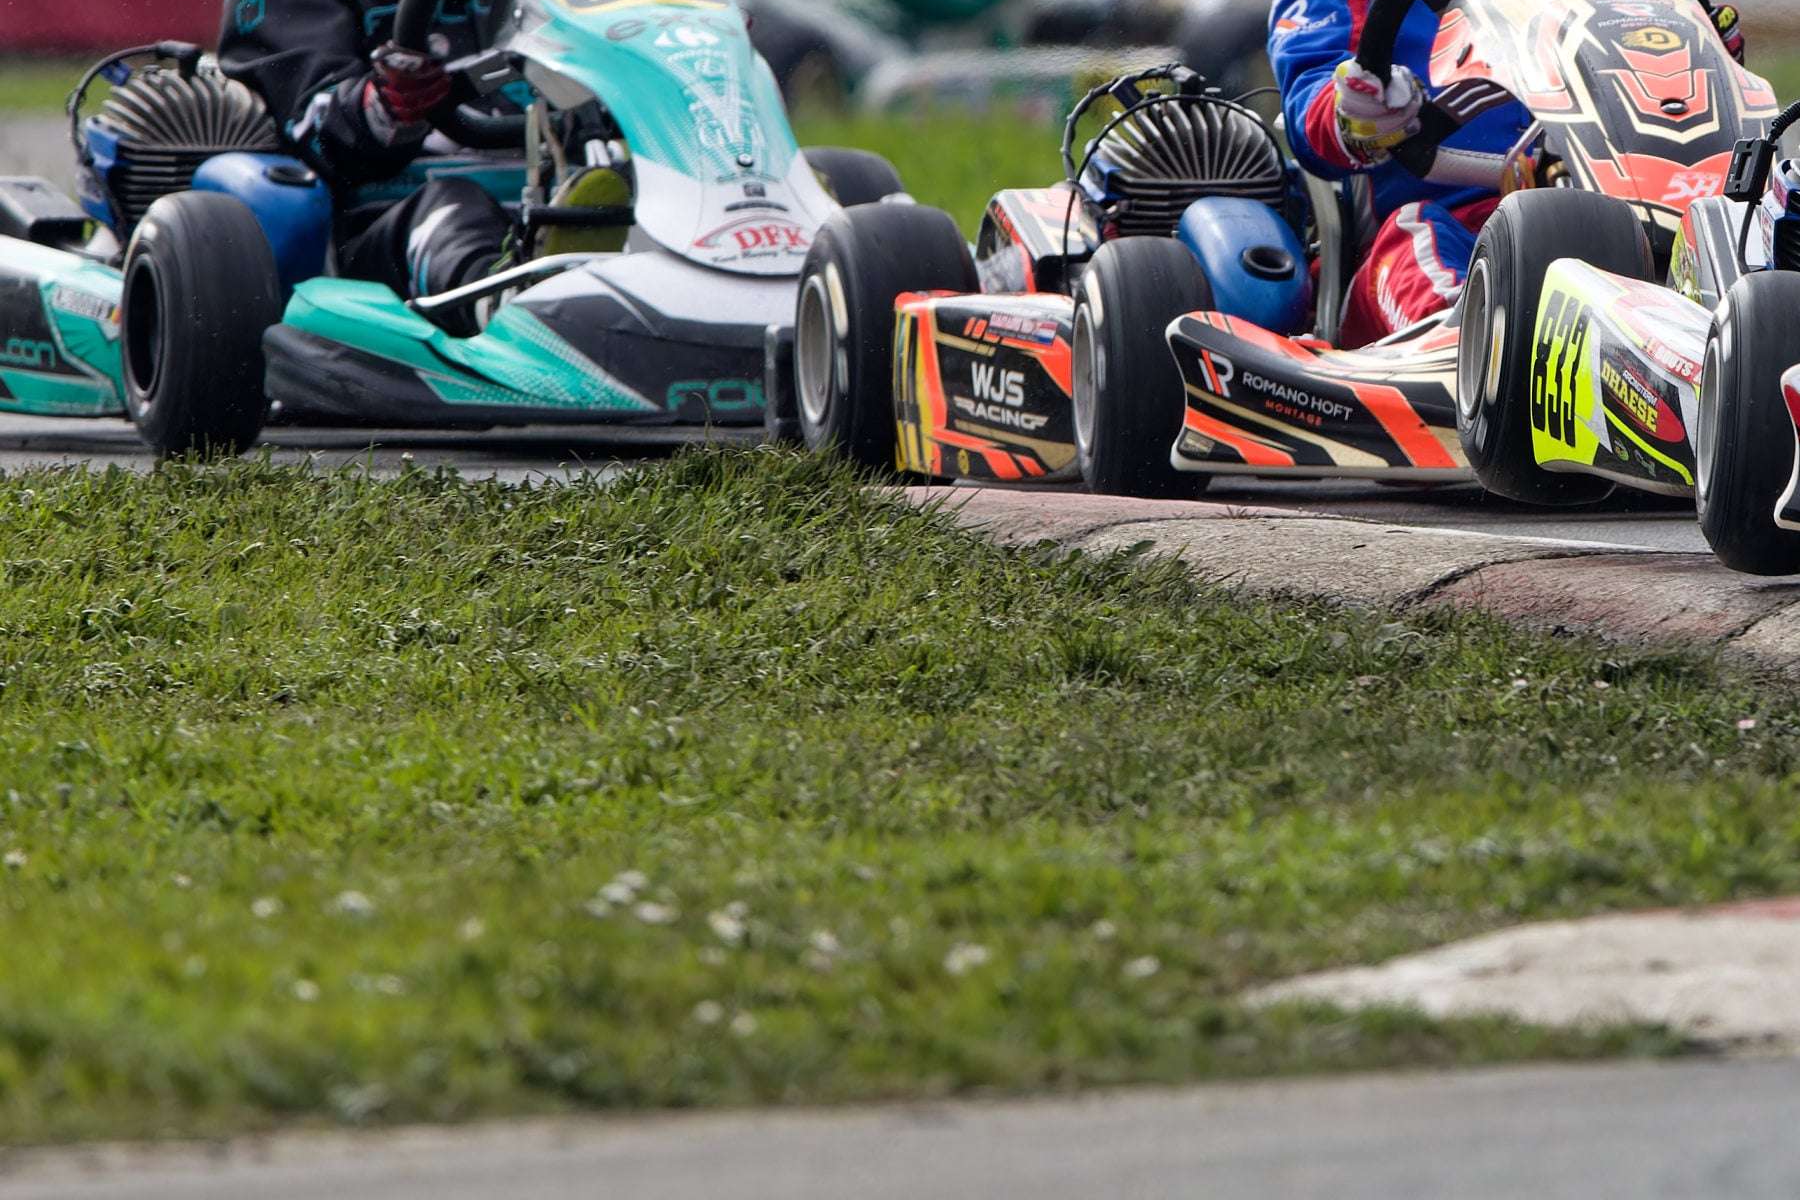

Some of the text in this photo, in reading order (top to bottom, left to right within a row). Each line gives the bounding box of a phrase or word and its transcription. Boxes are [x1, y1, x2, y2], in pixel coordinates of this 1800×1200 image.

[971, 361, 1025, 407] WJS
[1242, 371, 1354, 423] ROMANO HOFT
[1602, 360, 1658, 433] DHAESE
[953, 396, 1050, 431] RACING
[1265, 399, 1324, 427] MONTAGE
